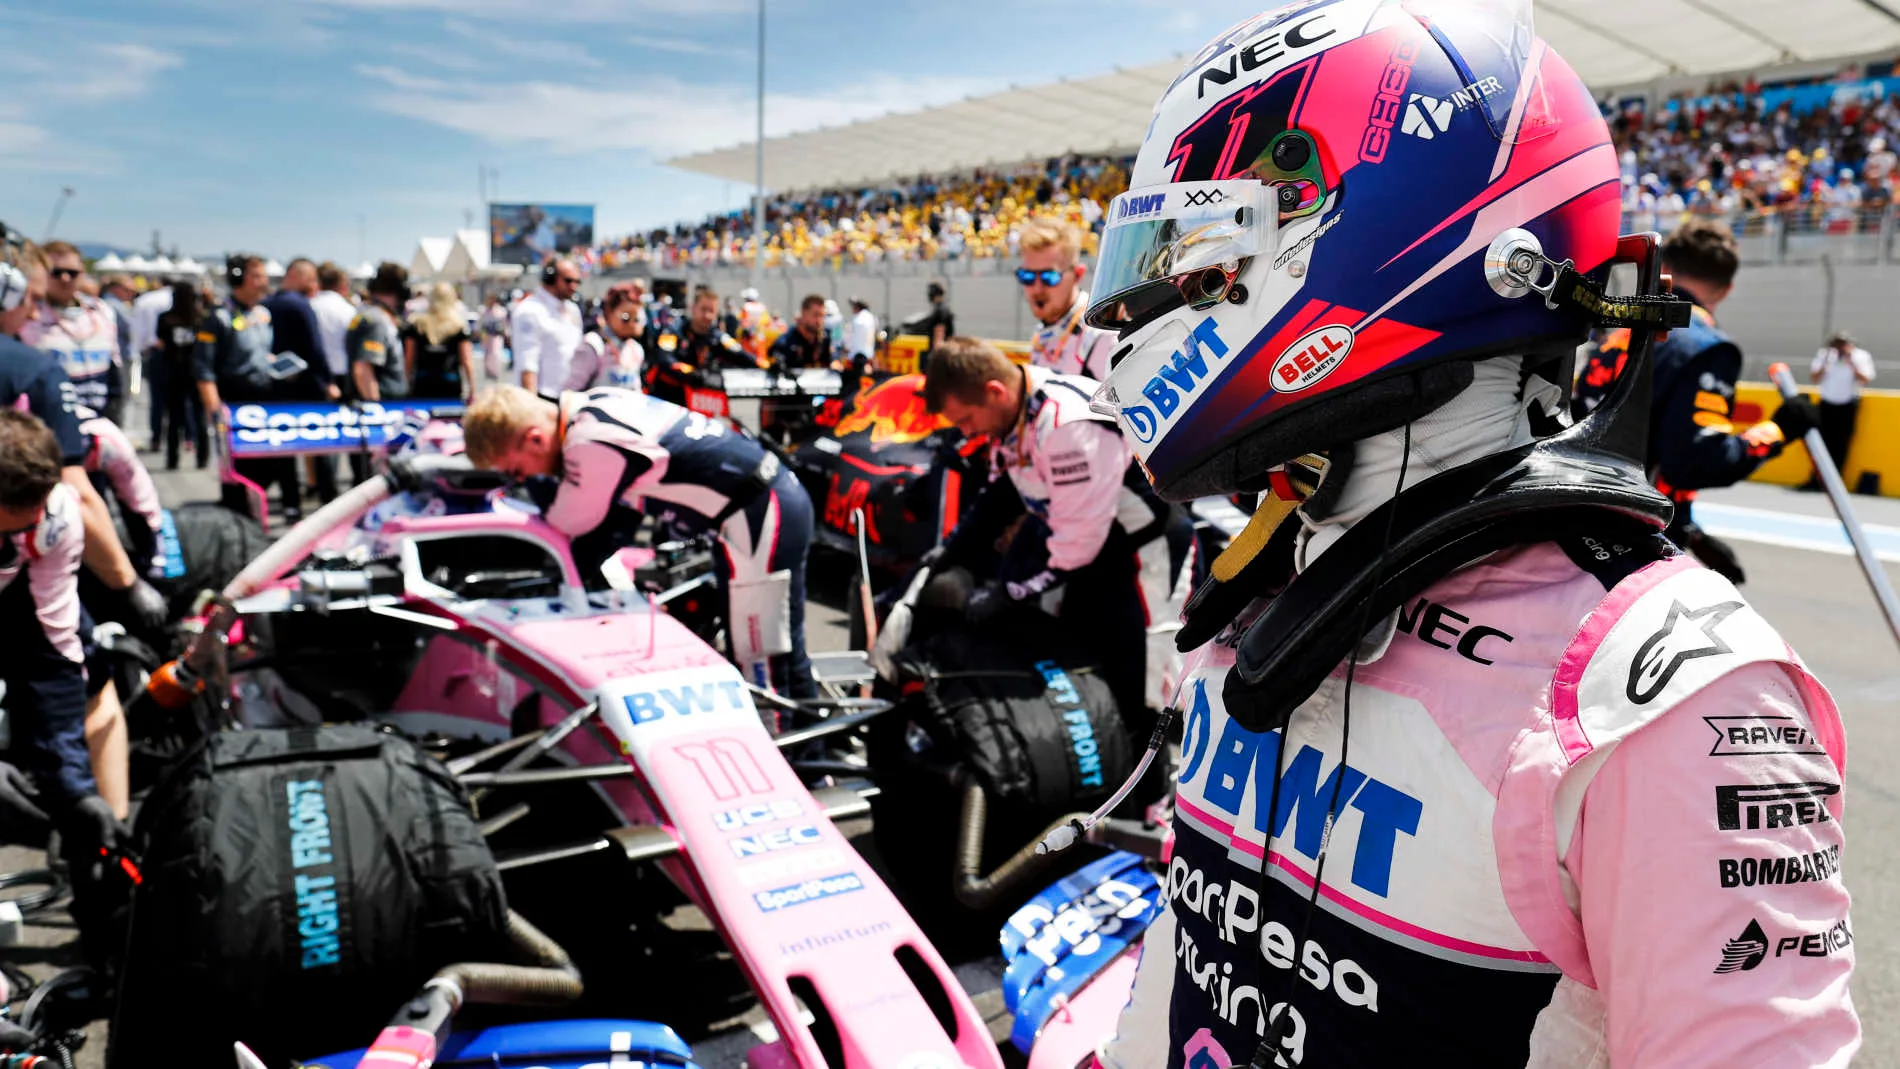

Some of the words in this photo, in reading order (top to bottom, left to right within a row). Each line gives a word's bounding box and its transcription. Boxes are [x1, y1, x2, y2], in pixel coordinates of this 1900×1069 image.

[1198, 14, 1337, 99] NEC
[1450, 75, 1503, 109] INTER
[1128, 192, 1166, 217] BWT
[1142, 316, 1230, 420] BWT
[1278, 335, 1344, 385] BELL
[1302, 357, 1336, 383] HELMETS
[1396, 598, 1515, 666] NEC
[623, 680, 744, 725] BWT
[1034, 659, 1081, 704] LEFT
[1062, 708, 1103, 786] FRONT
[672, 736, 775, 801] 11
[286, 779, 334, 869] FRONT
[711, 798, 803, 832] JCB
[1203, 716, 1424, 899] BWT
[728, 826, 825, 859] NEC
[294, 873, 341, 970] RIGHT
[779, 921, 893, 956] infinitum
[1775, 919, 1853, 958] PEMEX
